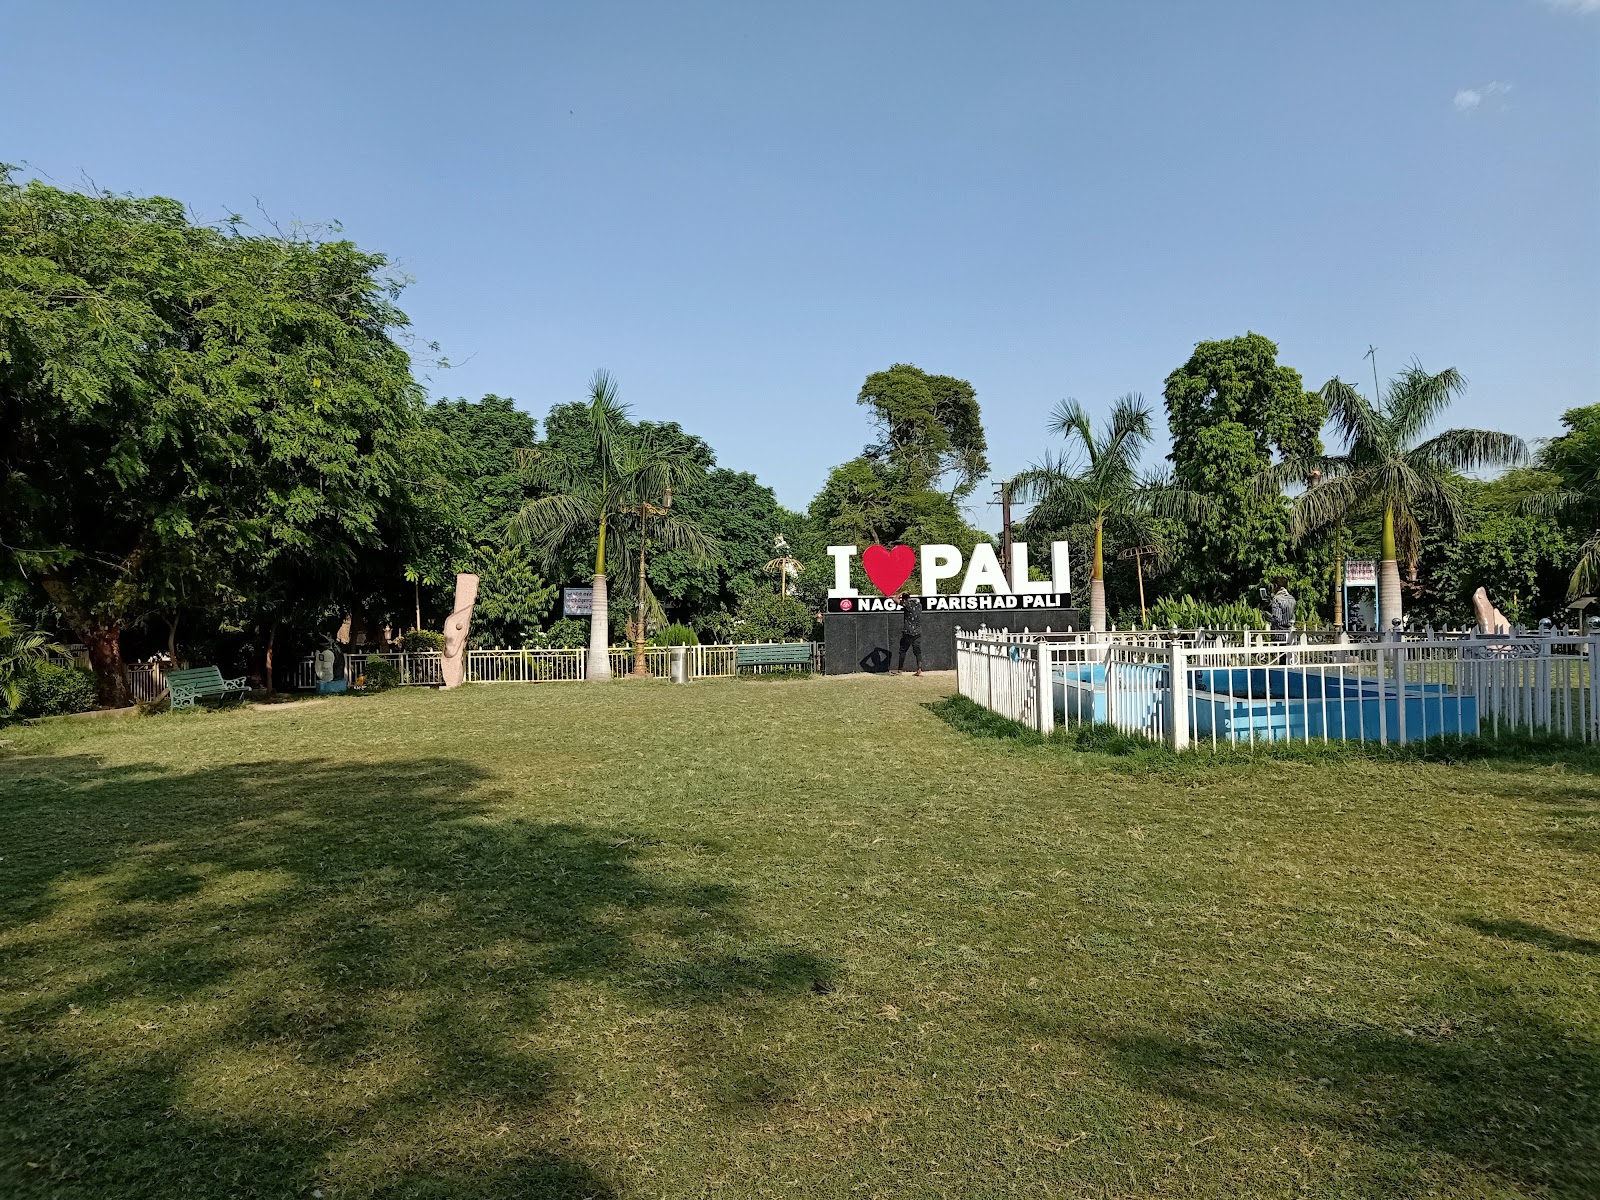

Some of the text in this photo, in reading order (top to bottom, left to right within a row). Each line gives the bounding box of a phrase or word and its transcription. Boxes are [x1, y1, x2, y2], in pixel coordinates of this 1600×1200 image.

[827, 541, 1071, 598] I PALI
[858, 594, 1061, 611] NAG PARISHAD PALI
